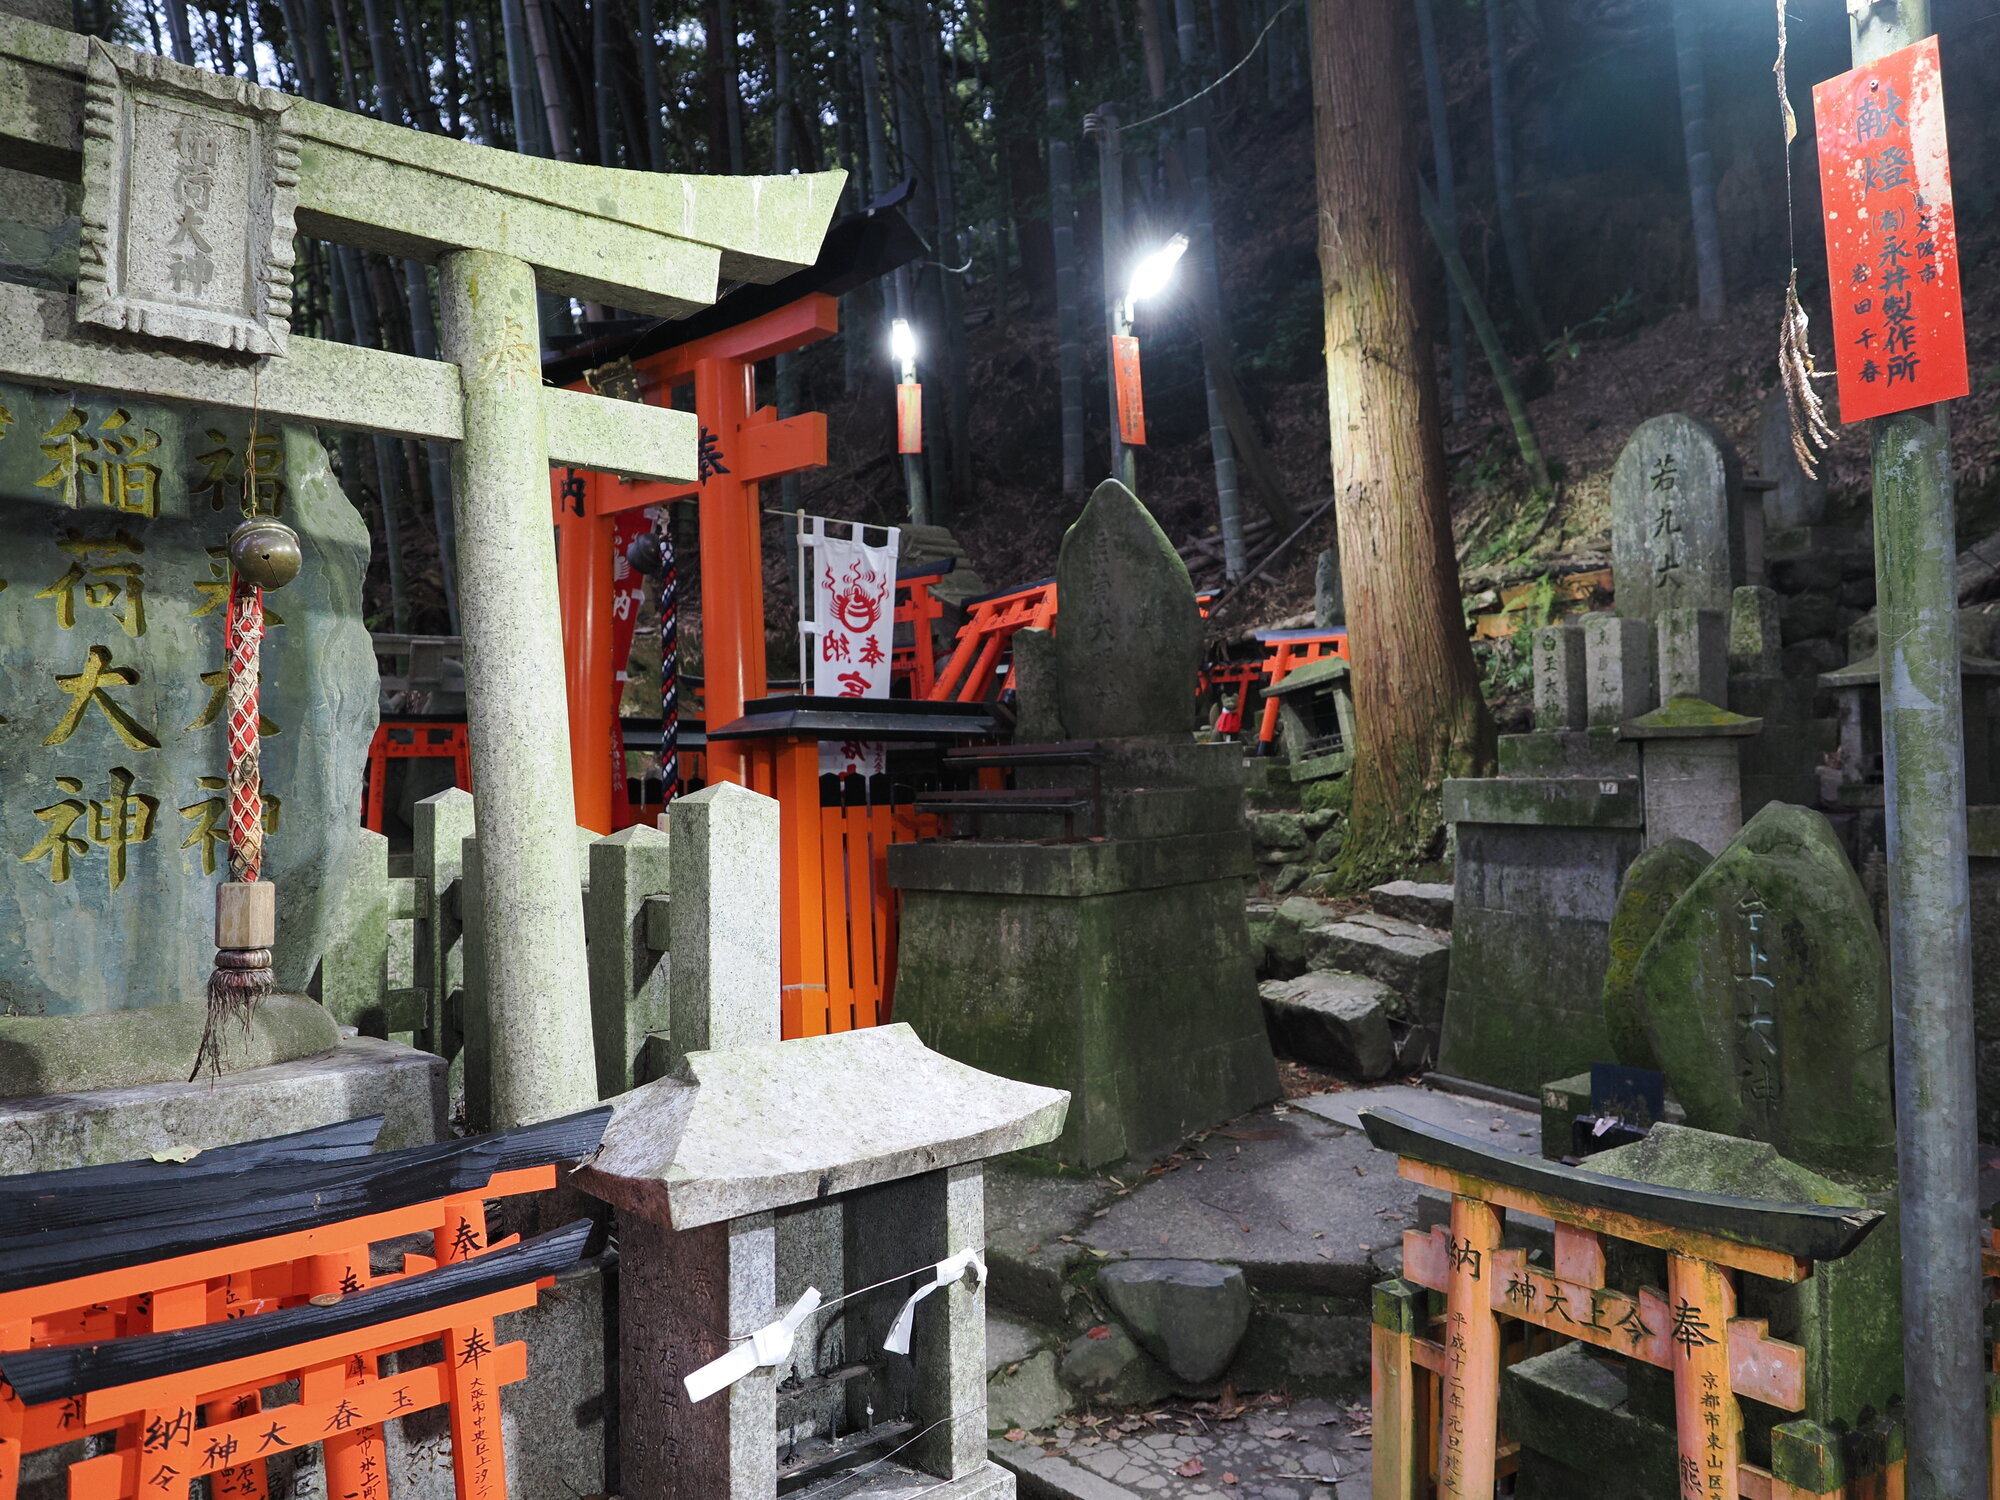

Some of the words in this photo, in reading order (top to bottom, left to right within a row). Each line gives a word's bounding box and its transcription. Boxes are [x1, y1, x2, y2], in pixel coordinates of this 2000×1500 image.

[1856, 87, 1911, 194] 献燈
[1849, 262, 1882, 384] 岩田千春
[19, 406, 162, 893] 稲荷大神
[450, 1216, 484, 1260] 奉
[1448, 1234, 1482, 1282] 納
[455, 1327, 491, 1371] 奉
[1671, 1297, 1720, 1361] 奉
[144, 1406, 192, 1454] 納
[1680, 1453, 1704, 1500] 熊
